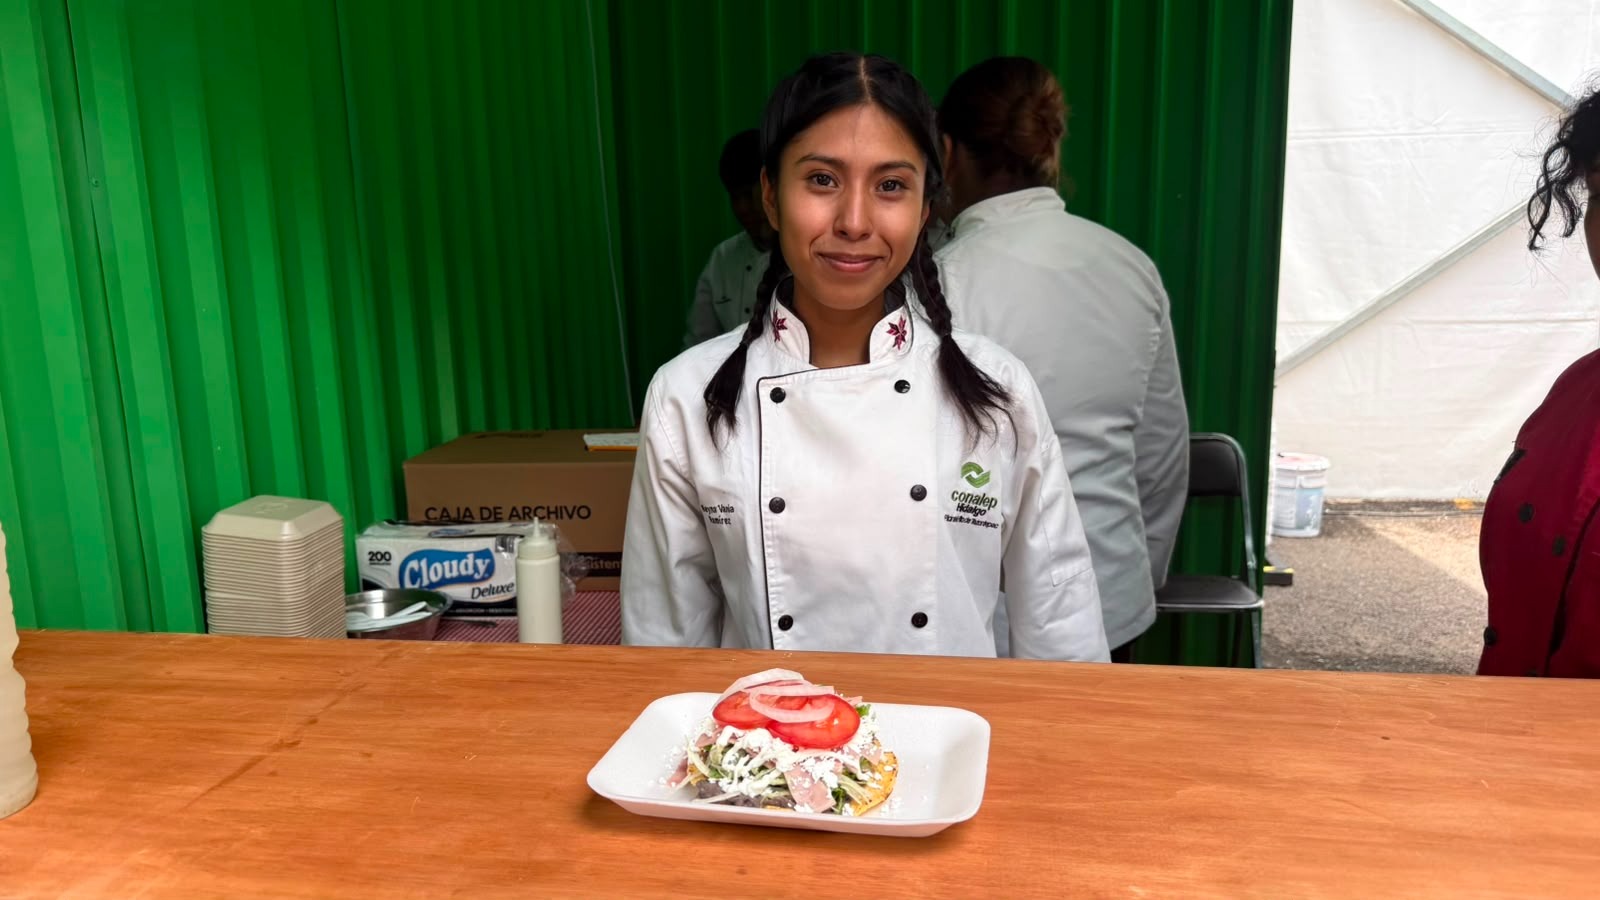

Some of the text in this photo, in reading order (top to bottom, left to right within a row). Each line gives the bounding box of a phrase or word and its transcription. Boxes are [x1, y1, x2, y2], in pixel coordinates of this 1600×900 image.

[951, 490, 998, 511] conalep
[424, 505, 592, 521] CAJA DE ARCHIVO
[956, 502, 987, 517] Hidalgo
[368, 551, 392, 562] 200
[403, 553, 491, 589] Cloudy
[471, 582, 515, 599] Deluxe
